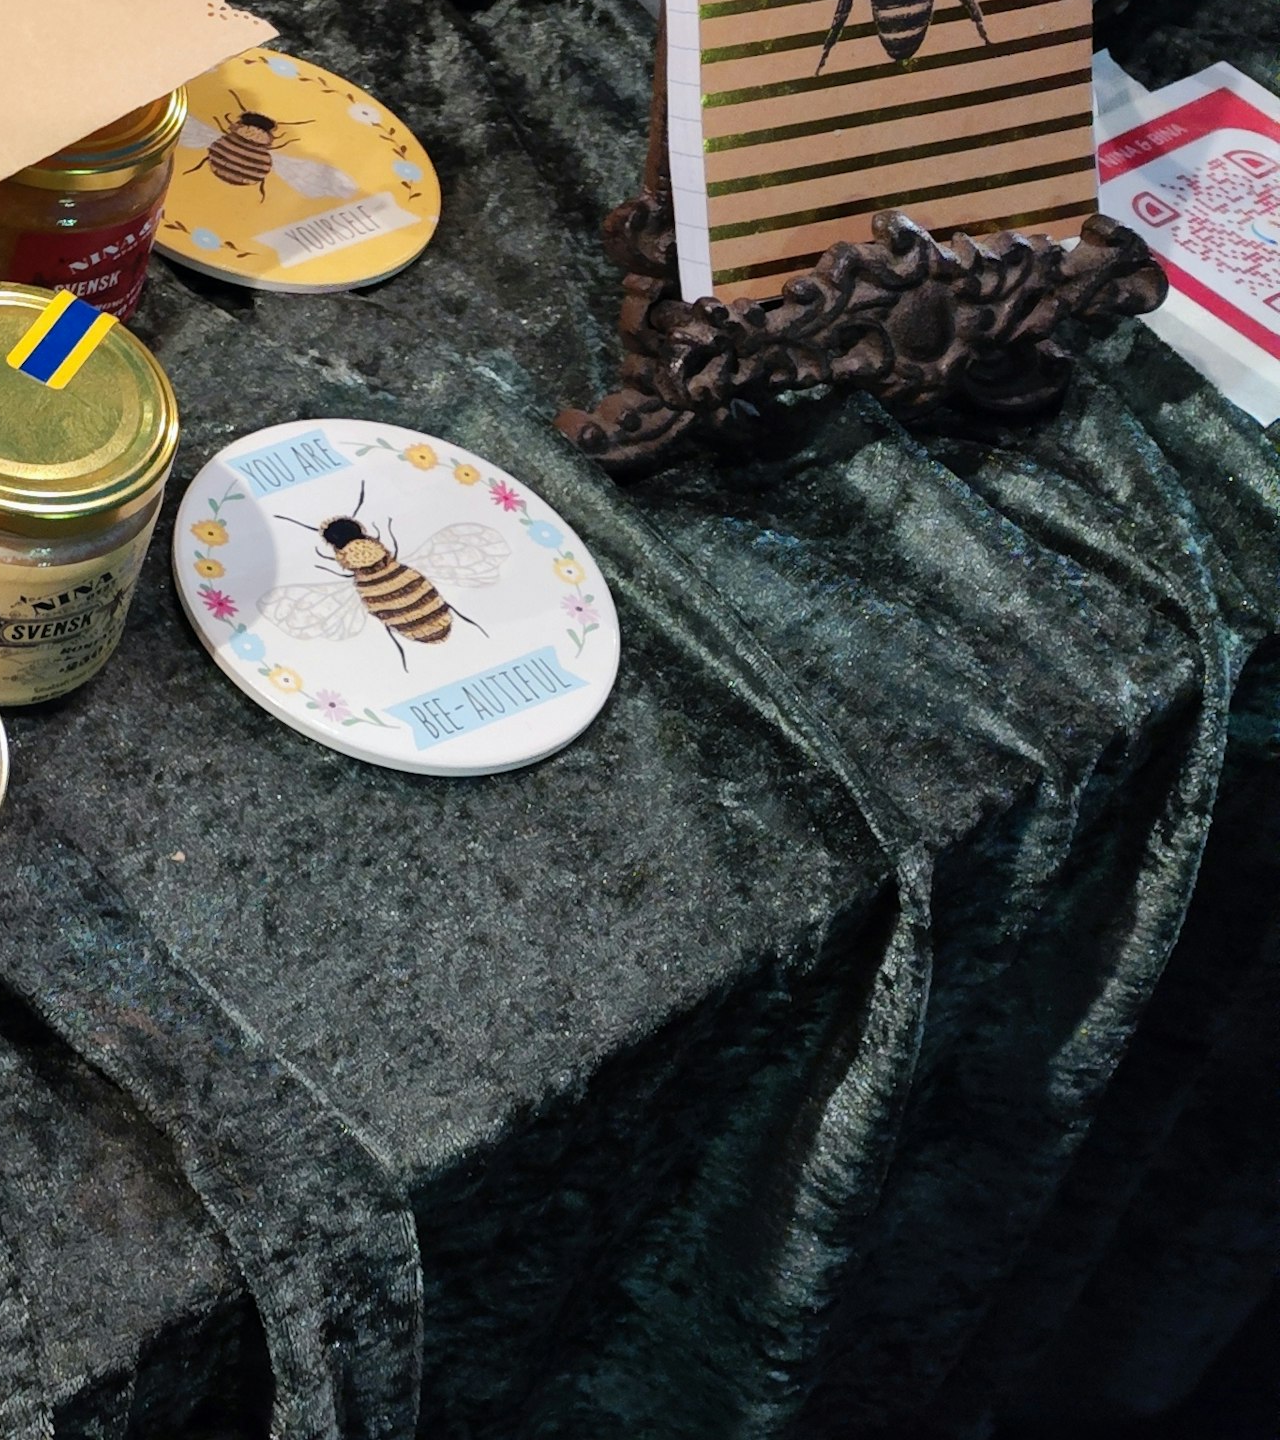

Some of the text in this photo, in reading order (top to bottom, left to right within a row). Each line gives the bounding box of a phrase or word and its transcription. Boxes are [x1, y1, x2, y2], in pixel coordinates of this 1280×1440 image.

[284, 204, 381, 254] YOURSELF
[68, 233, 137, 276] NINA
[239, 437, 343, 492] YOU ARE
[31, 571, 115, 618] NINA
[11, 611, 95, 641] SVENSK
[409, 657, 573, 740] BEE-AUTIFUL
